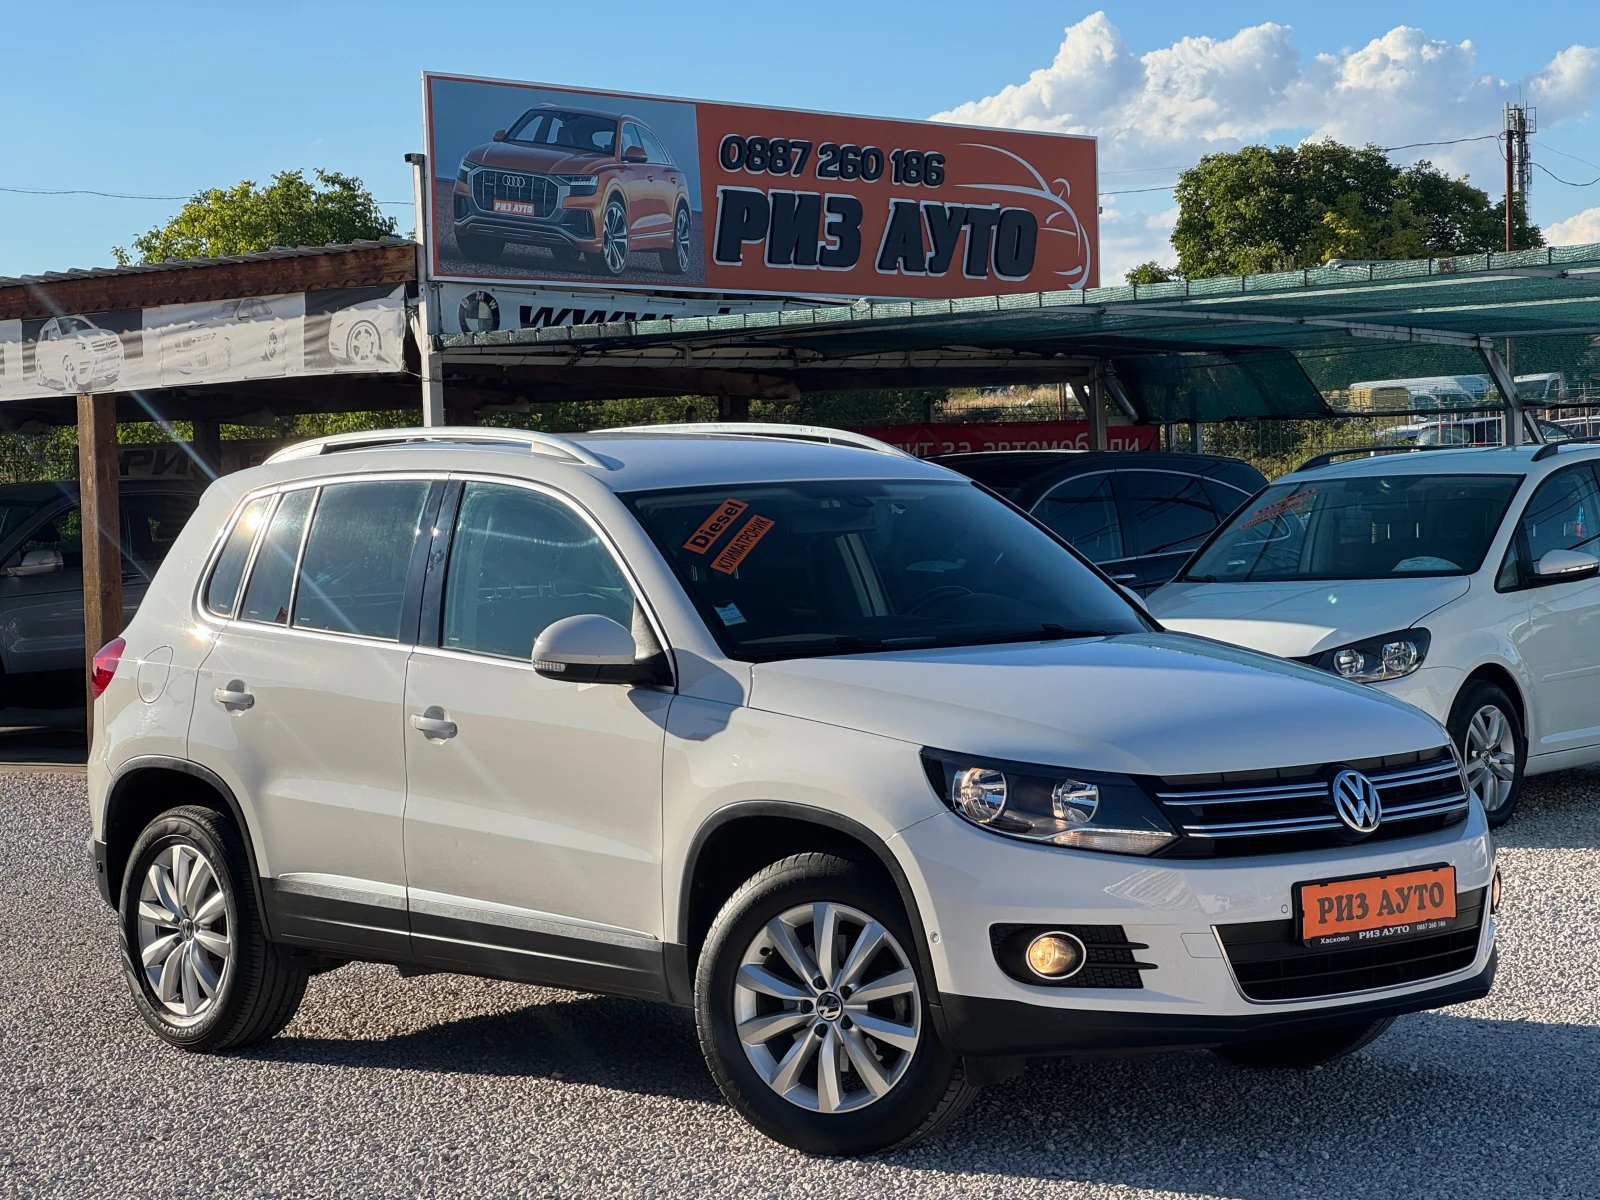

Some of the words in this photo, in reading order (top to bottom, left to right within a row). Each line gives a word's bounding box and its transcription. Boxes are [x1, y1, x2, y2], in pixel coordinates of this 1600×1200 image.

[719, 133, 812, 176] 0887
[816, 142, 884, 182] 260
[889, 148, 945, 188] 186
[494, 202, 512, 212] РИЗ
[513, 203, 533, 214] АУТО
[713, 185, 863, 272] РИЗ
[875, 197, 1038, 282] АУТО
[459, 291, 498, 310] BMW
[689, 501, 743, 548] Diesel
[715, 517, 771, 571] КЛИМАТРОНИК
[1317, 892, 1369, 924] РИЗ
[1377, 882, 1444, 917] АУТО
[1320, 935, 1350, 945] Хасково
[1359, 929, 1380, 939] РИЗ
[1382, 925, 1410, 937] АУТО
